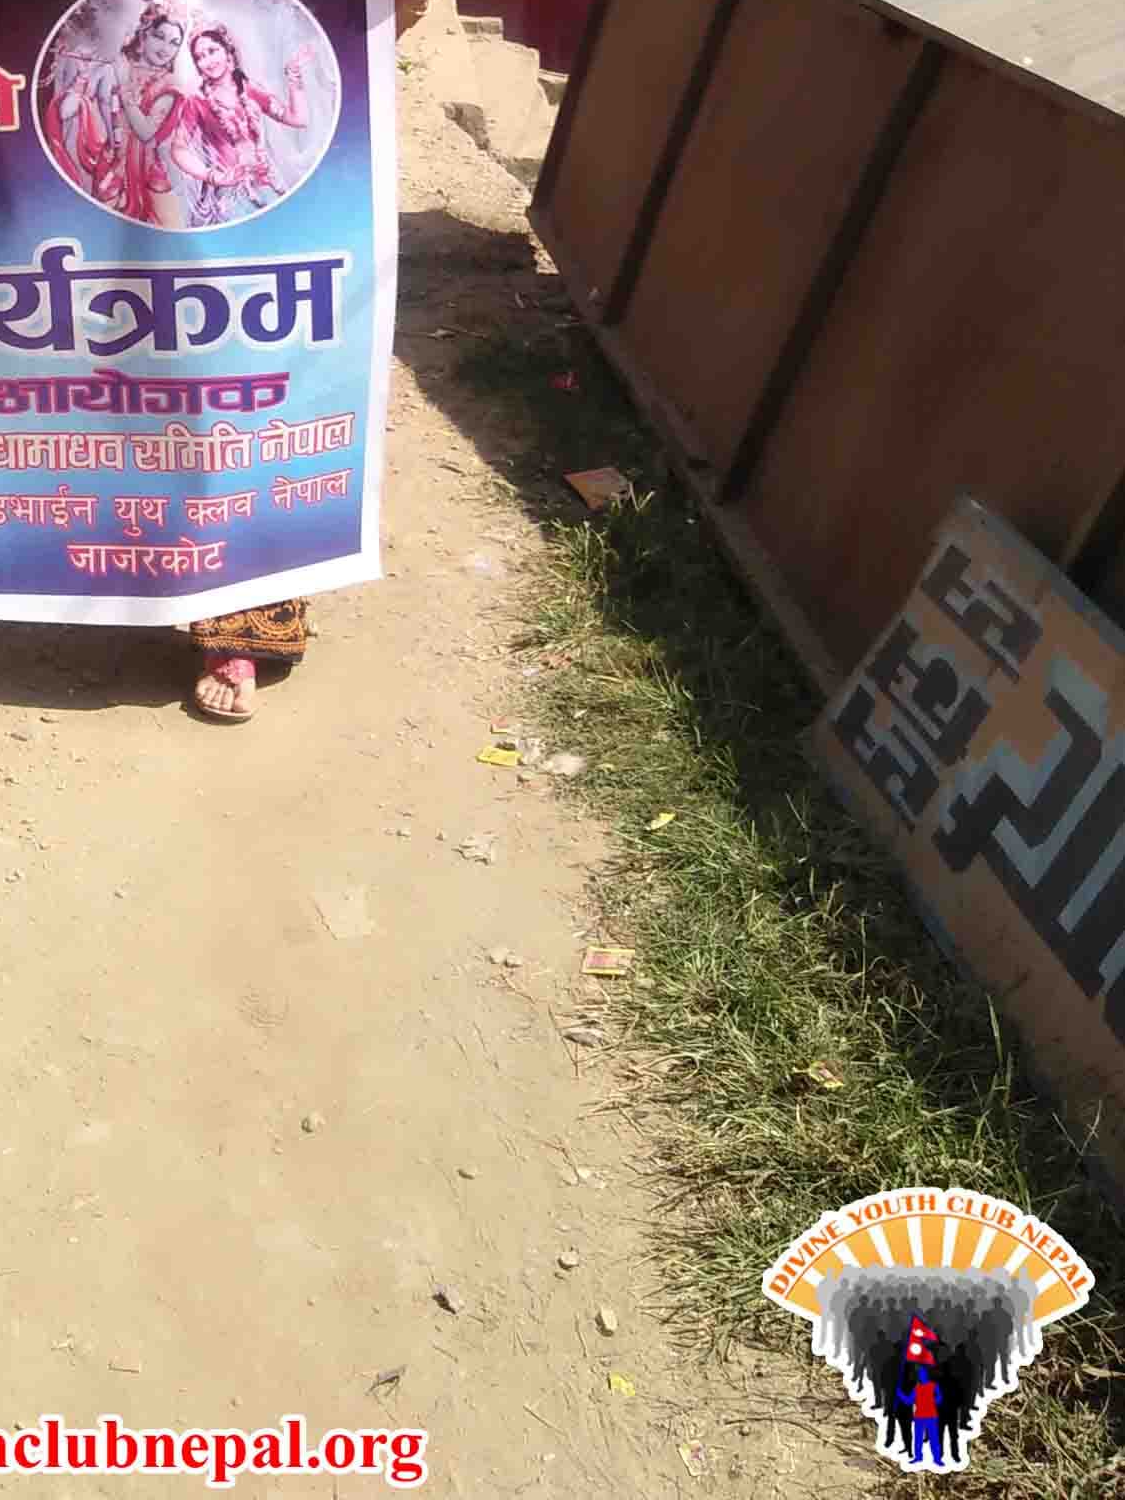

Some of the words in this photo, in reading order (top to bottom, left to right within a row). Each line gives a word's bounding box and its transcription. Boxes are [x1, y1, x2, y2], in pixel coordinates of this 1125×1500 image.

[130, 420, 253, 473] समिति
[257, 412, 355, 463] नेपाल
[112, 495, 167, 537] युथ
[271, 467, 352, 511] नेपाल
[66, 536, 226, 577] जाजरकोट
